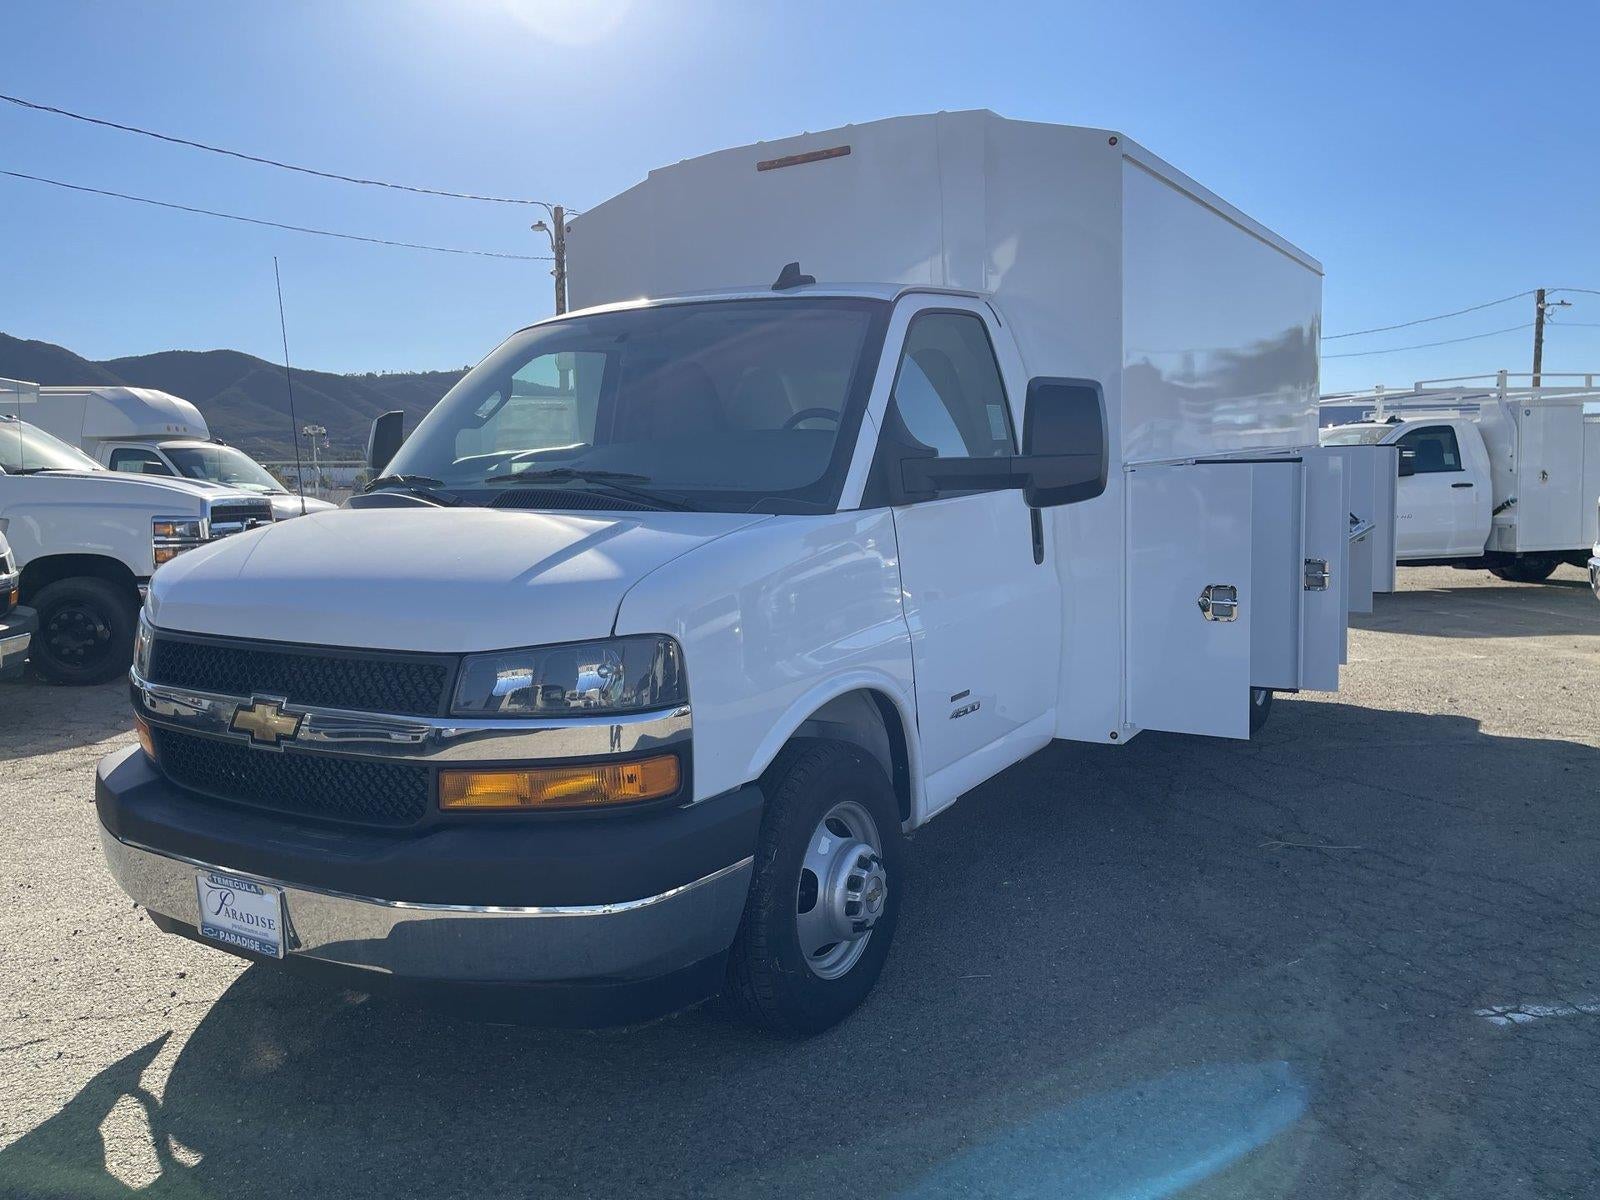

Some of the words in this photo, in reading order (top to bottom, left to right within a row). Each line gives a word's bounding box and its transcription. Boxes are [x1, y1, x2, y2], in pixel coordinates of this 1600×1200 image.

[949, 701, 981, 720] 4500
[212, 876, 257, 893] TEMECULA
[204, 881, 276, 931] PARADISE
[219, 931, 260, 951] PARADISE
